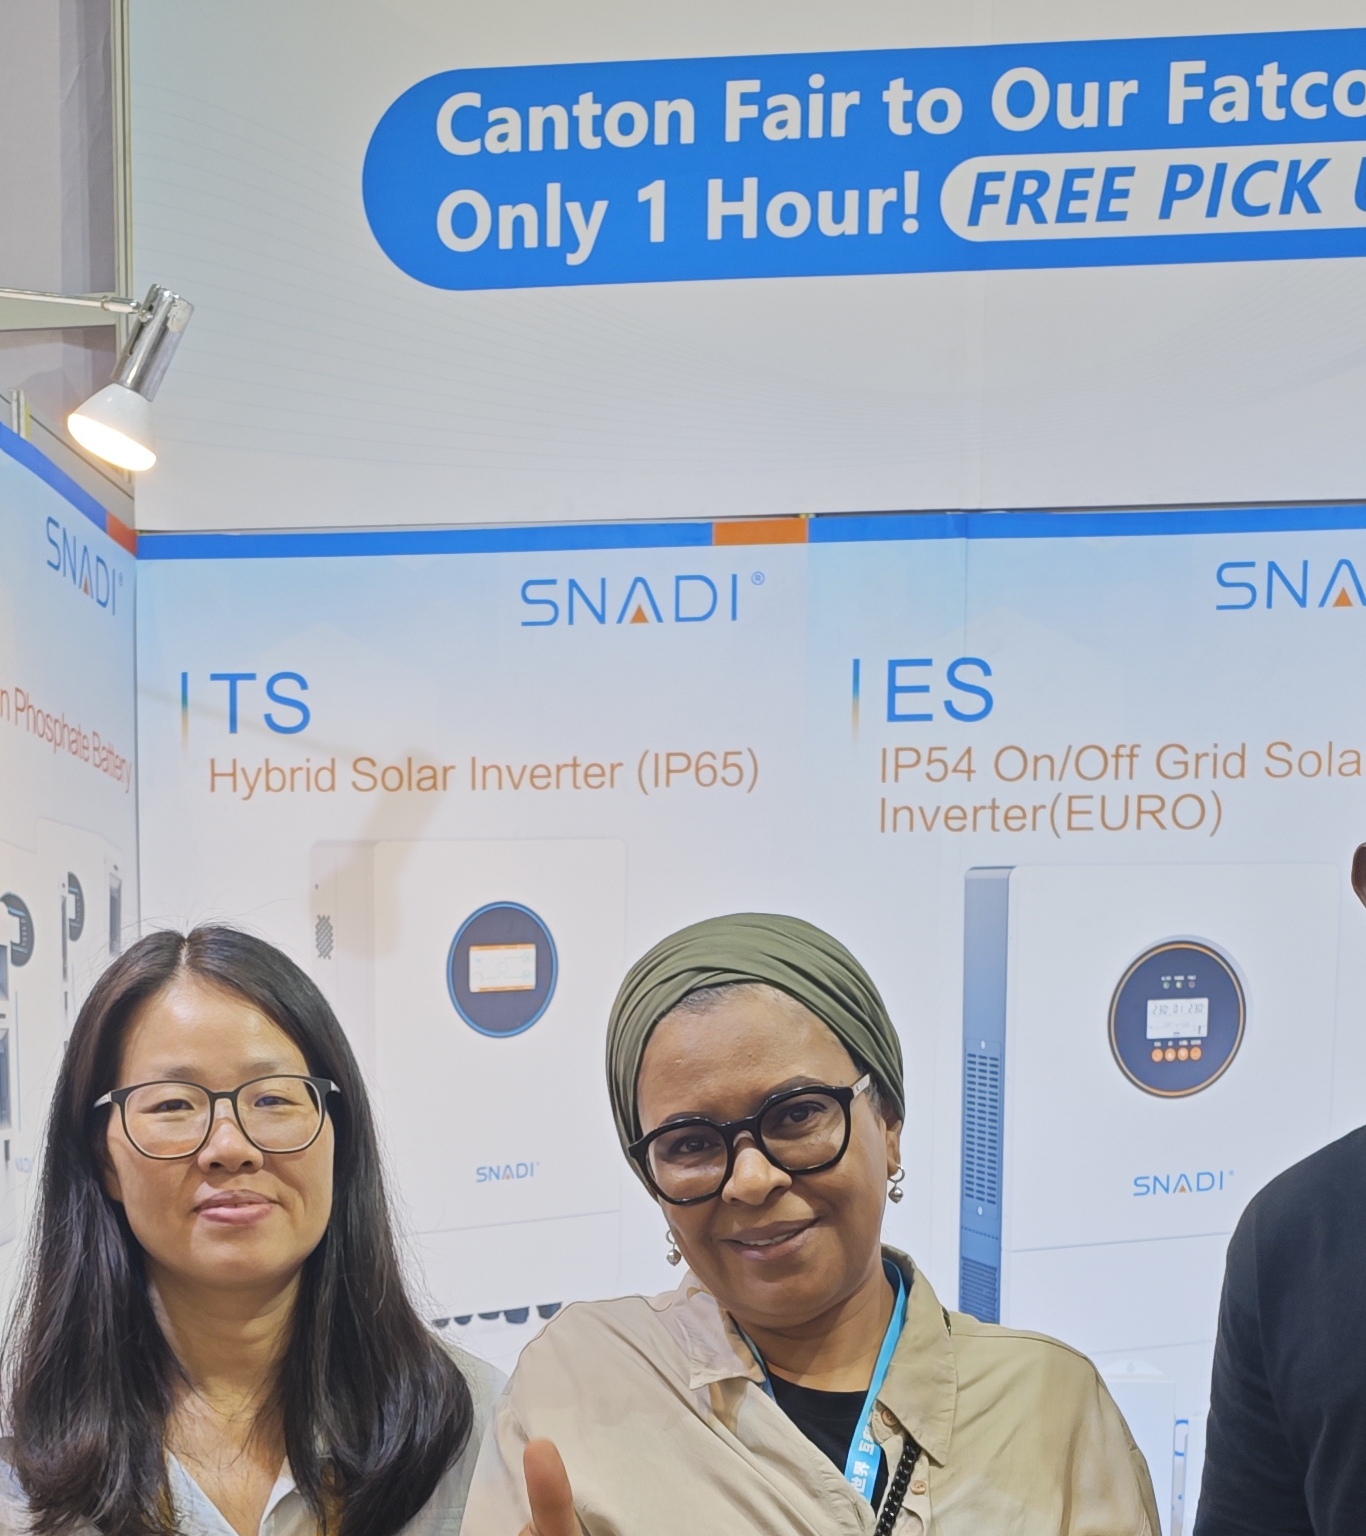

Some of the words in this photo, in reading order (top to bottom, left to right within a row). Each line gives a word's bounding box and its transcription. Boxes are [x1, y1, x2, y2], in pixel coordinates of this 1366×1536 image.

[436, 92, 696, 156] Canton
[724, 74, 860, 144] Fair
[883, 77, 963, 136] to
[990, 66, 1139, 132] Our
[436, 183, 609, 266] Only
[637, 180, 665, 243] 1
[707, 170, 921, 241] Hour!
[967, 164, 1131, 227] FREE
[1158, 158, 1334, 220] PICK
[210, 671, 311, 735] TS
[886, 657, 994, 723] ES
[14, 686, 91, 764] Phosphate
[92, 731, 133, 794] Battery
[880, 746, 976, 783] IP54
[994, 743, 1139, 782] On/Off
[1155, 743, 1246, 780] Grid
[210, 758, 336, 801] Hybrid
[351, 756, 455, 793] Solar
[470, 754, 623, 791] Inverter
[637, 747, 759, 795] (IP65)
[880, 790, 1223, 837] Inverter(EURO)
